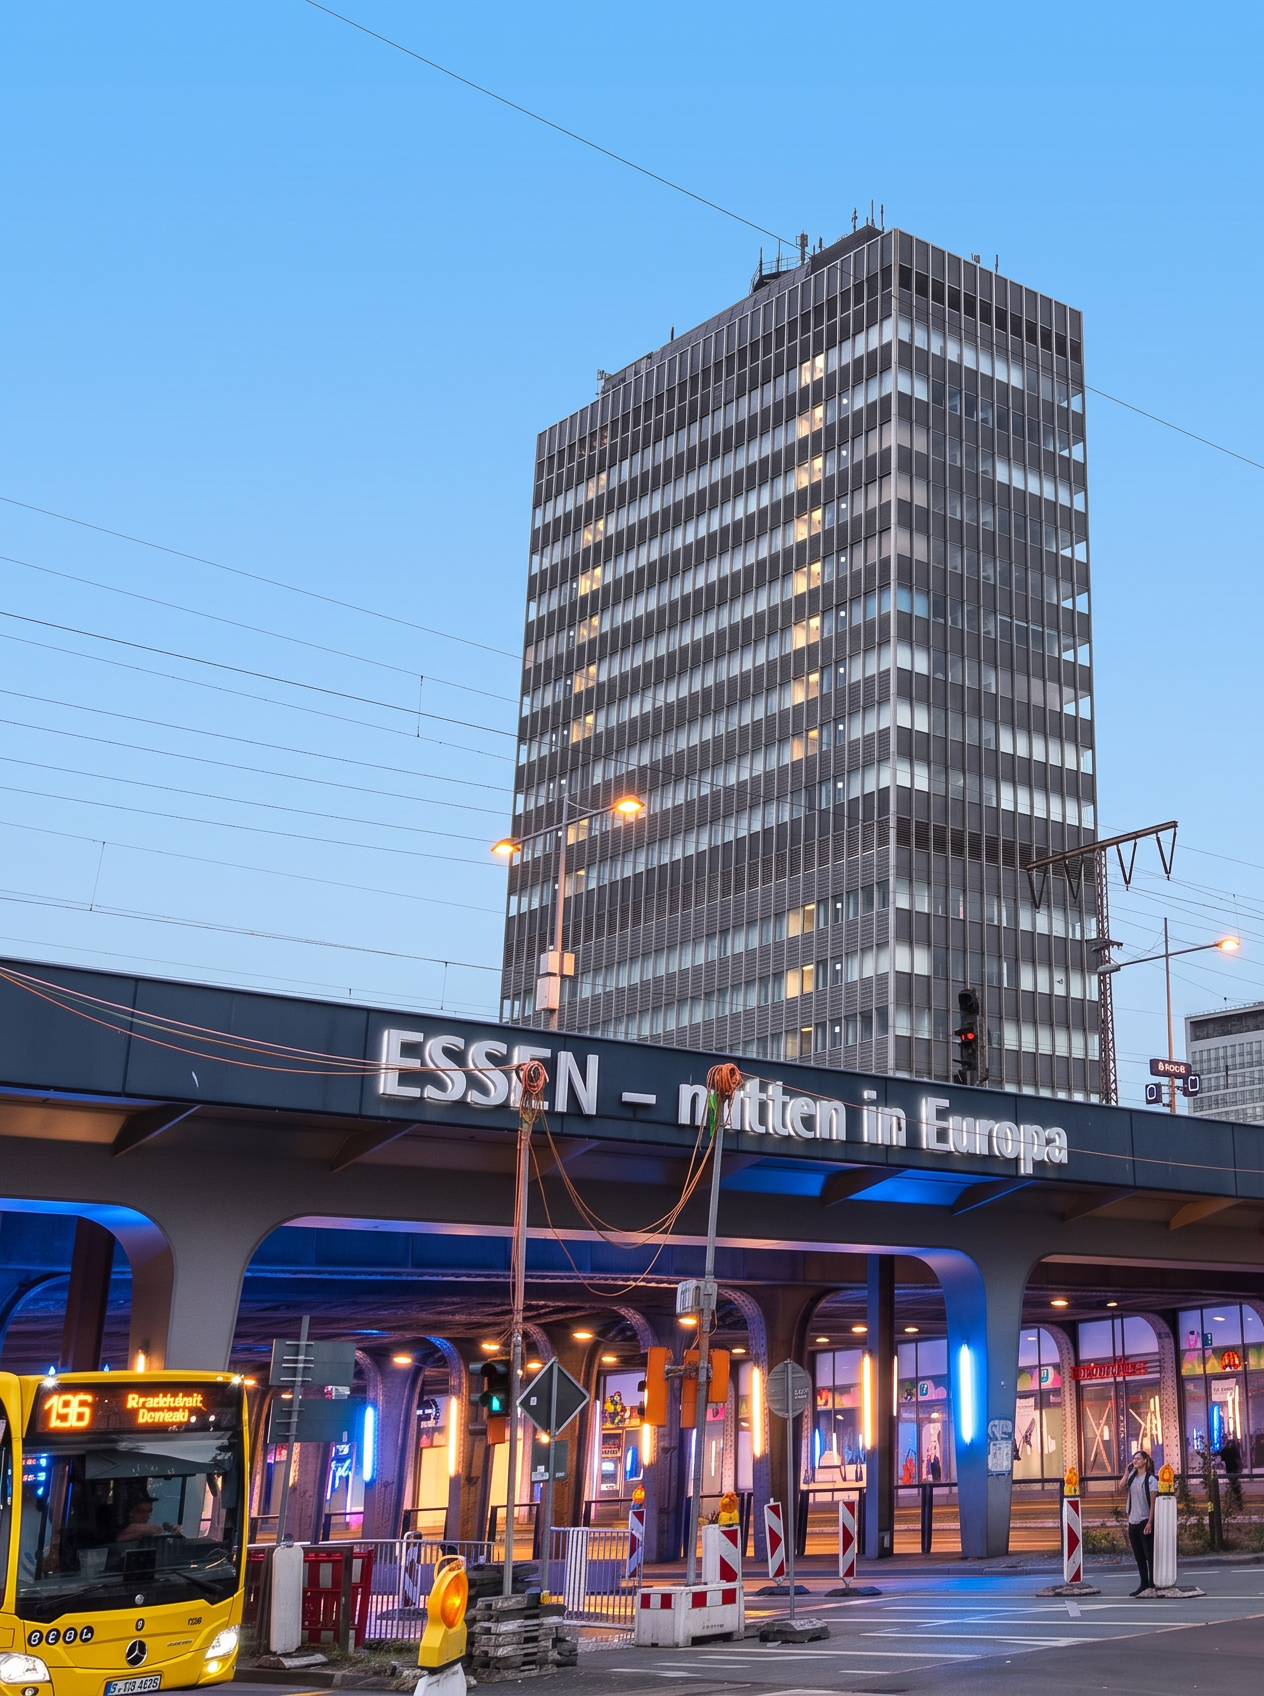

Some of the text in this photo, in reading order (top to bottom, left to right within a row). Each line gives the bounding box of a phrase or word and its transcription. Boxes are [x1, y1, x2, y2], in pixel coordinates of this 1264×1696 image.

[379, 1028, 600, 1116] ESSEN
[863, 1090, 907, 1147] in
[922, 1096, 1069, 1175] Europa
[44, 1394, 93, 1428] 196
